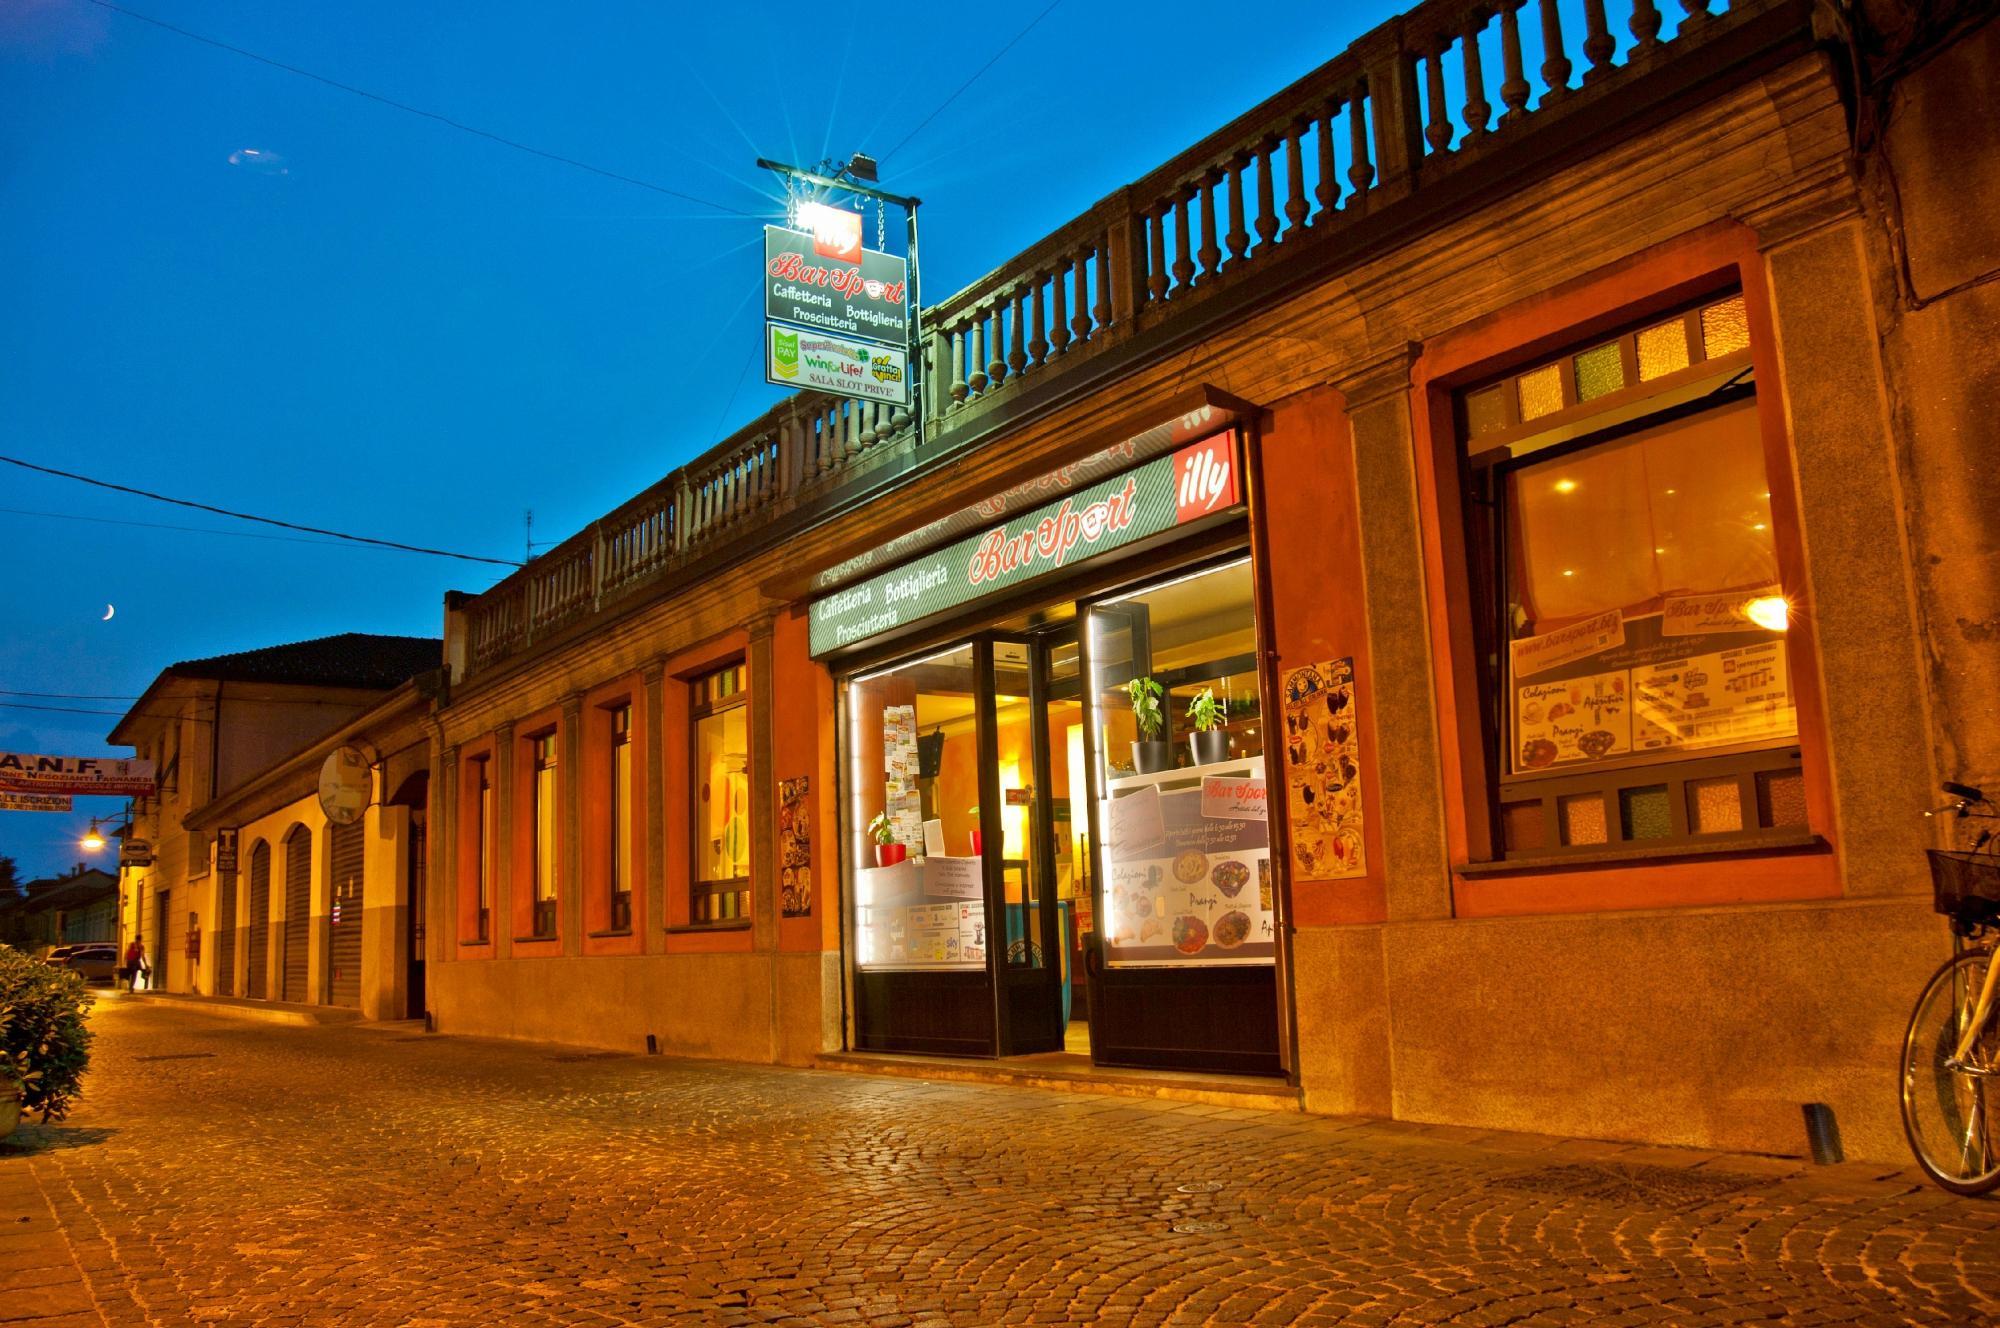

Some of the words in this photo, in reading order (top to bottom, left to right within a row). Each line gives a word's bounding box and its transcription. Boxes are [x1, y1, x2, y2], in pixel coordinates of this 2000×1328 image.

[768, 252, 829, 287] Bar
[773, 283, 832, 307] Caffetteria
[793, 307, 858, 331] Prosciutteria
[846, 305, 904, 329] Bottiglieria
[777, 346, 796, 358] PAY
[809, 373, 834, 386] SALA
[836, 379, 863, 391] SLOT
[1179, 448, 1230, 510] illy
[968, 527, 1036, 585] Bar
[885, 563, 948, 604] Bottiglieria
[818, 586, 872, 621] Caffetteria
[1667, 600, 1700, 618] Bar
[836, 607, 898, 645] Prosciutteria
[1517, 613, 1619, 657] www.barsport.biz
[1523, 683, 1567, 701] Colazioni
[1552, 723, 1585, 739] Pranzi
[1207, 779, 1233, 799] Bar
[1190, 892, 1218, 910] Pranzi
